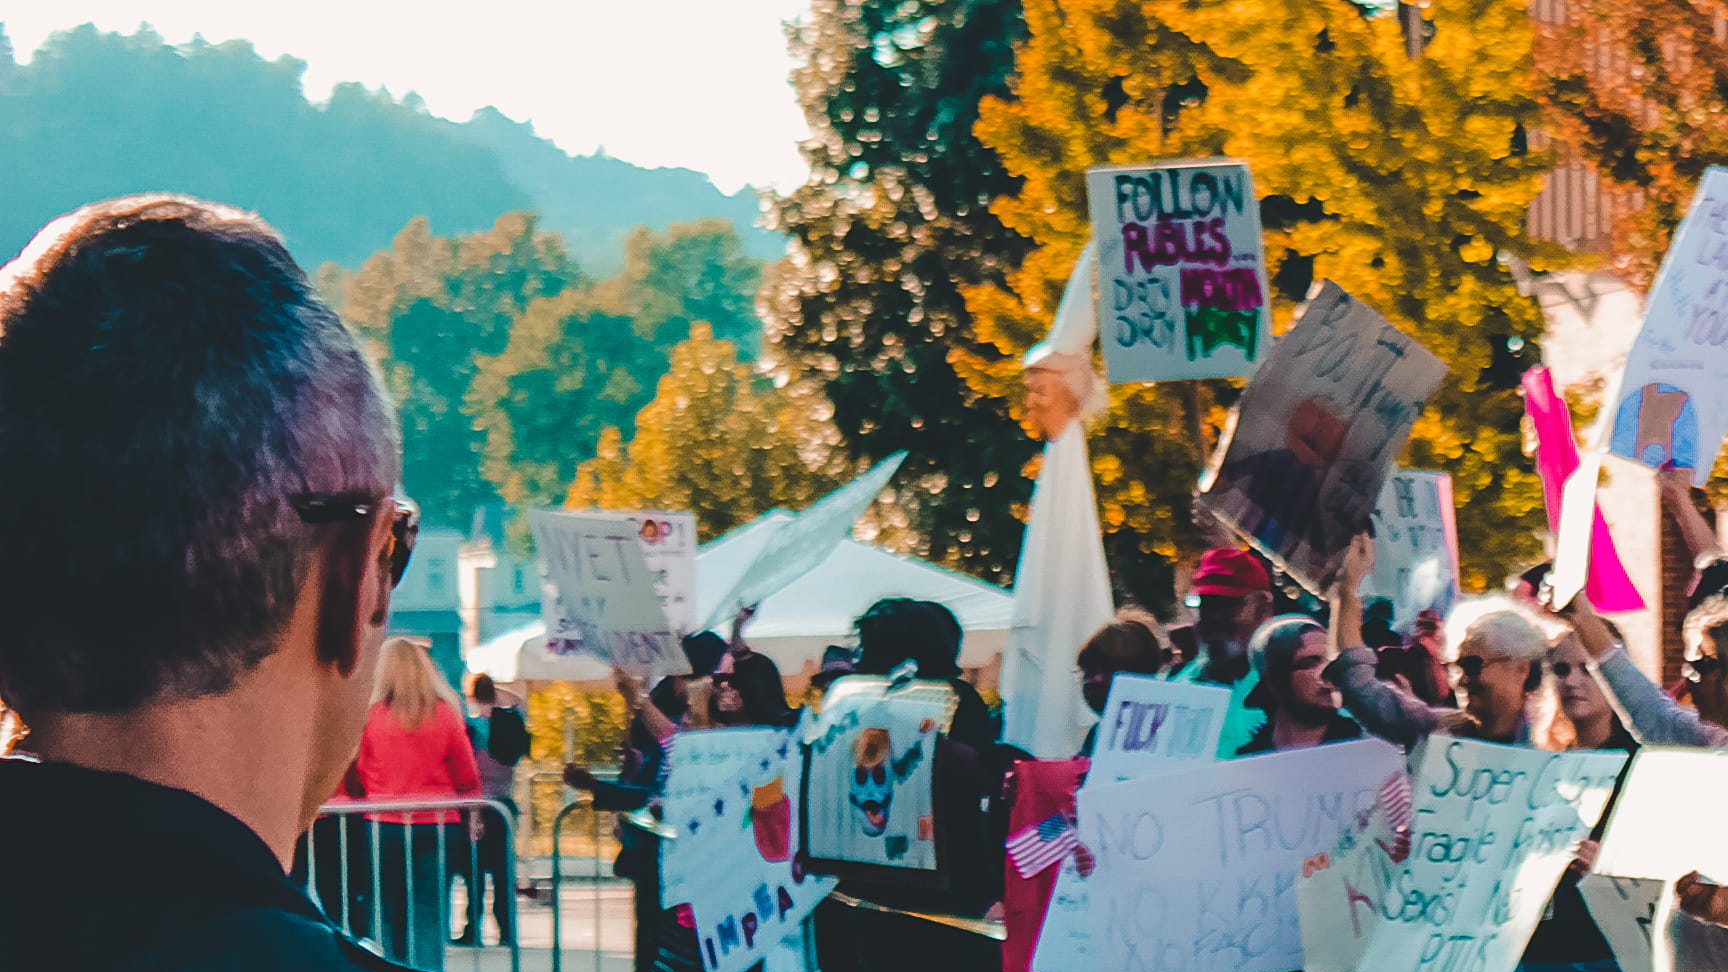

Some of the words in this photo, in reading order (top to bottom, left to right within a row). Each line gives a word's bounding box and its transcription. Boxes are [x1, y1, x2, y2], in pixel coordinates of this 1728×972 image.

[1114, 168, 1244, 223] FOLLOW
[1430, 741, 1528, 822] Super
[1096, 809, 1164, 872] NO
